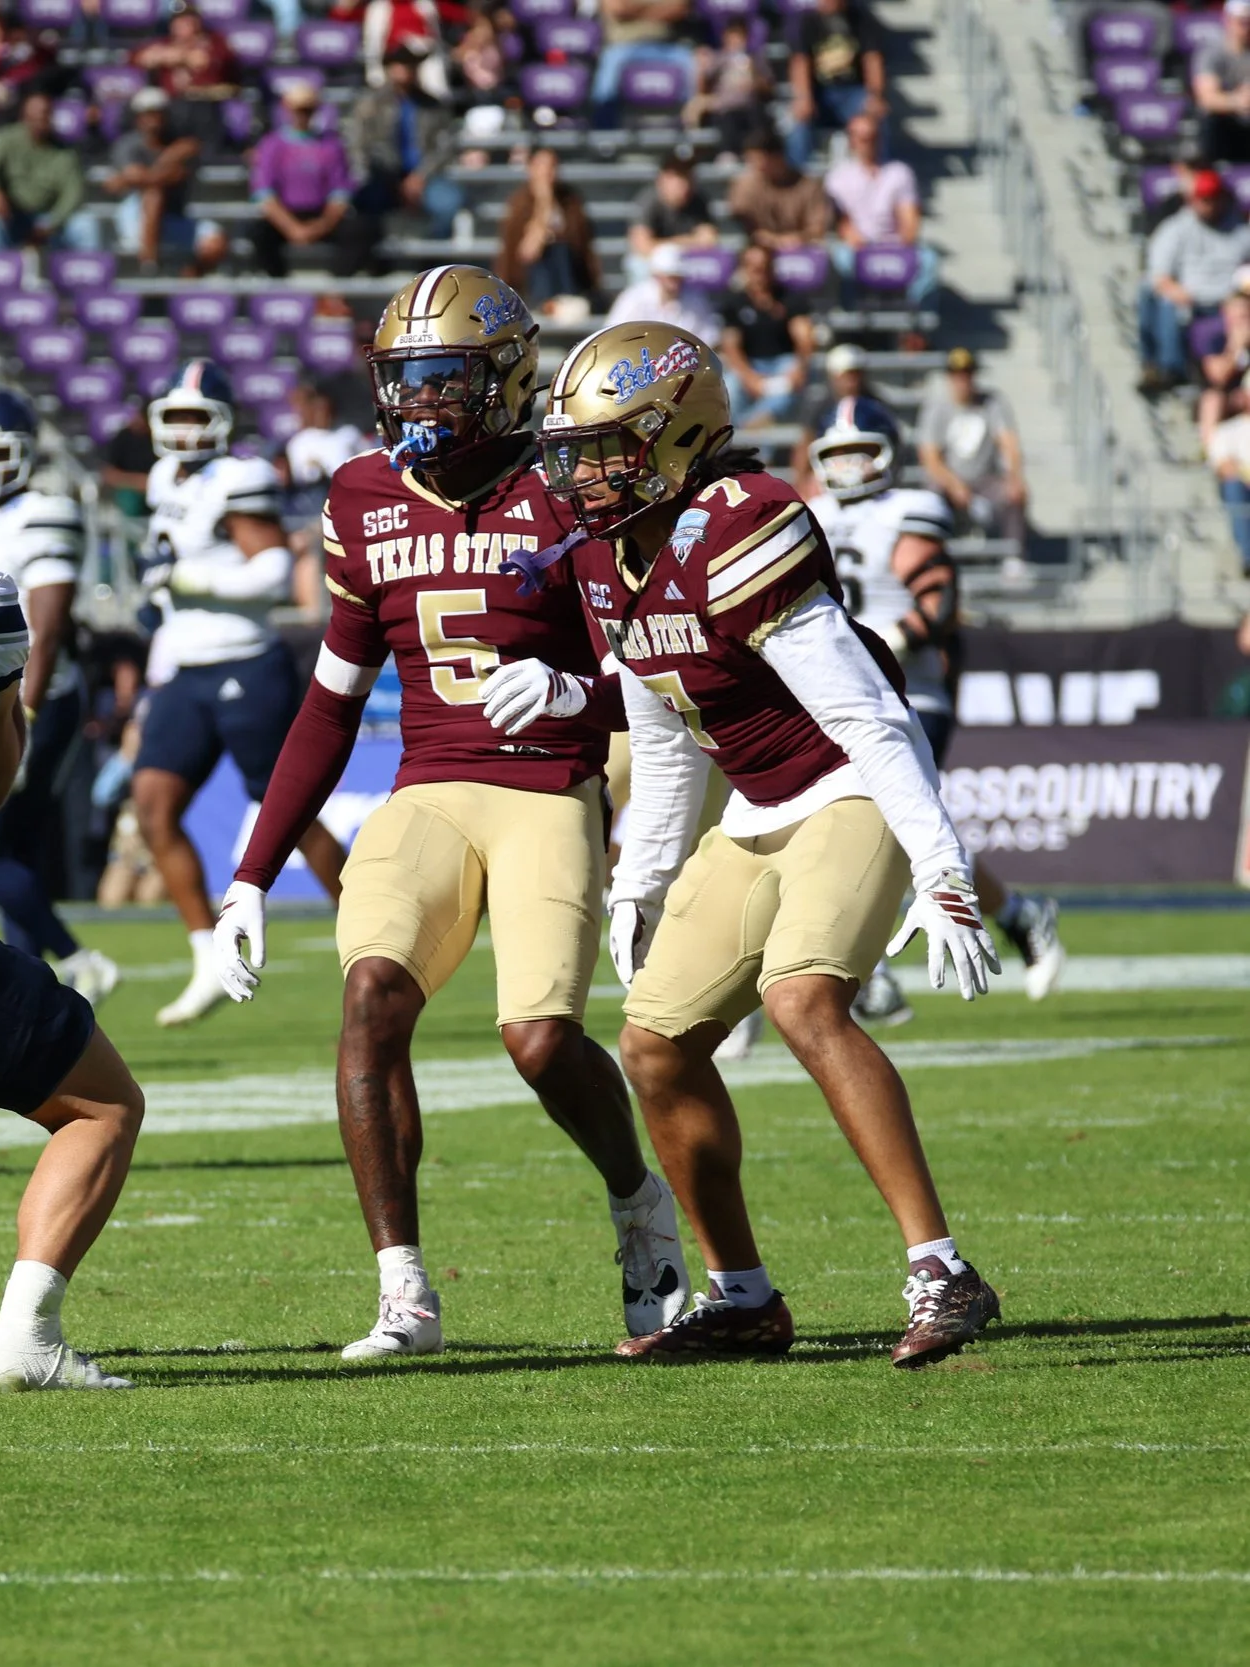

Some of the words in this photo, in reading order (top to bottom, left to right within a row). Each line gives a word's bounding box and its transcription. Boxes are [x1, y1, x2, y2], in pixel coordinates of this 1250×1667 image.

[400, 334, 433, 344] BOBCATS
[697, 477, 751, 508] 7
[362, 503, 409, 538] SBC
[366, 533, 444, 585] TEXAS
[416, 588, 501, 706] 5
[646, 614, 709, 656] STATE
[635, 670, 720, 750] 7
[941, 762, 1223, 820] SSCOUNTRY
[955, 817, 1070, 852] GAGE
